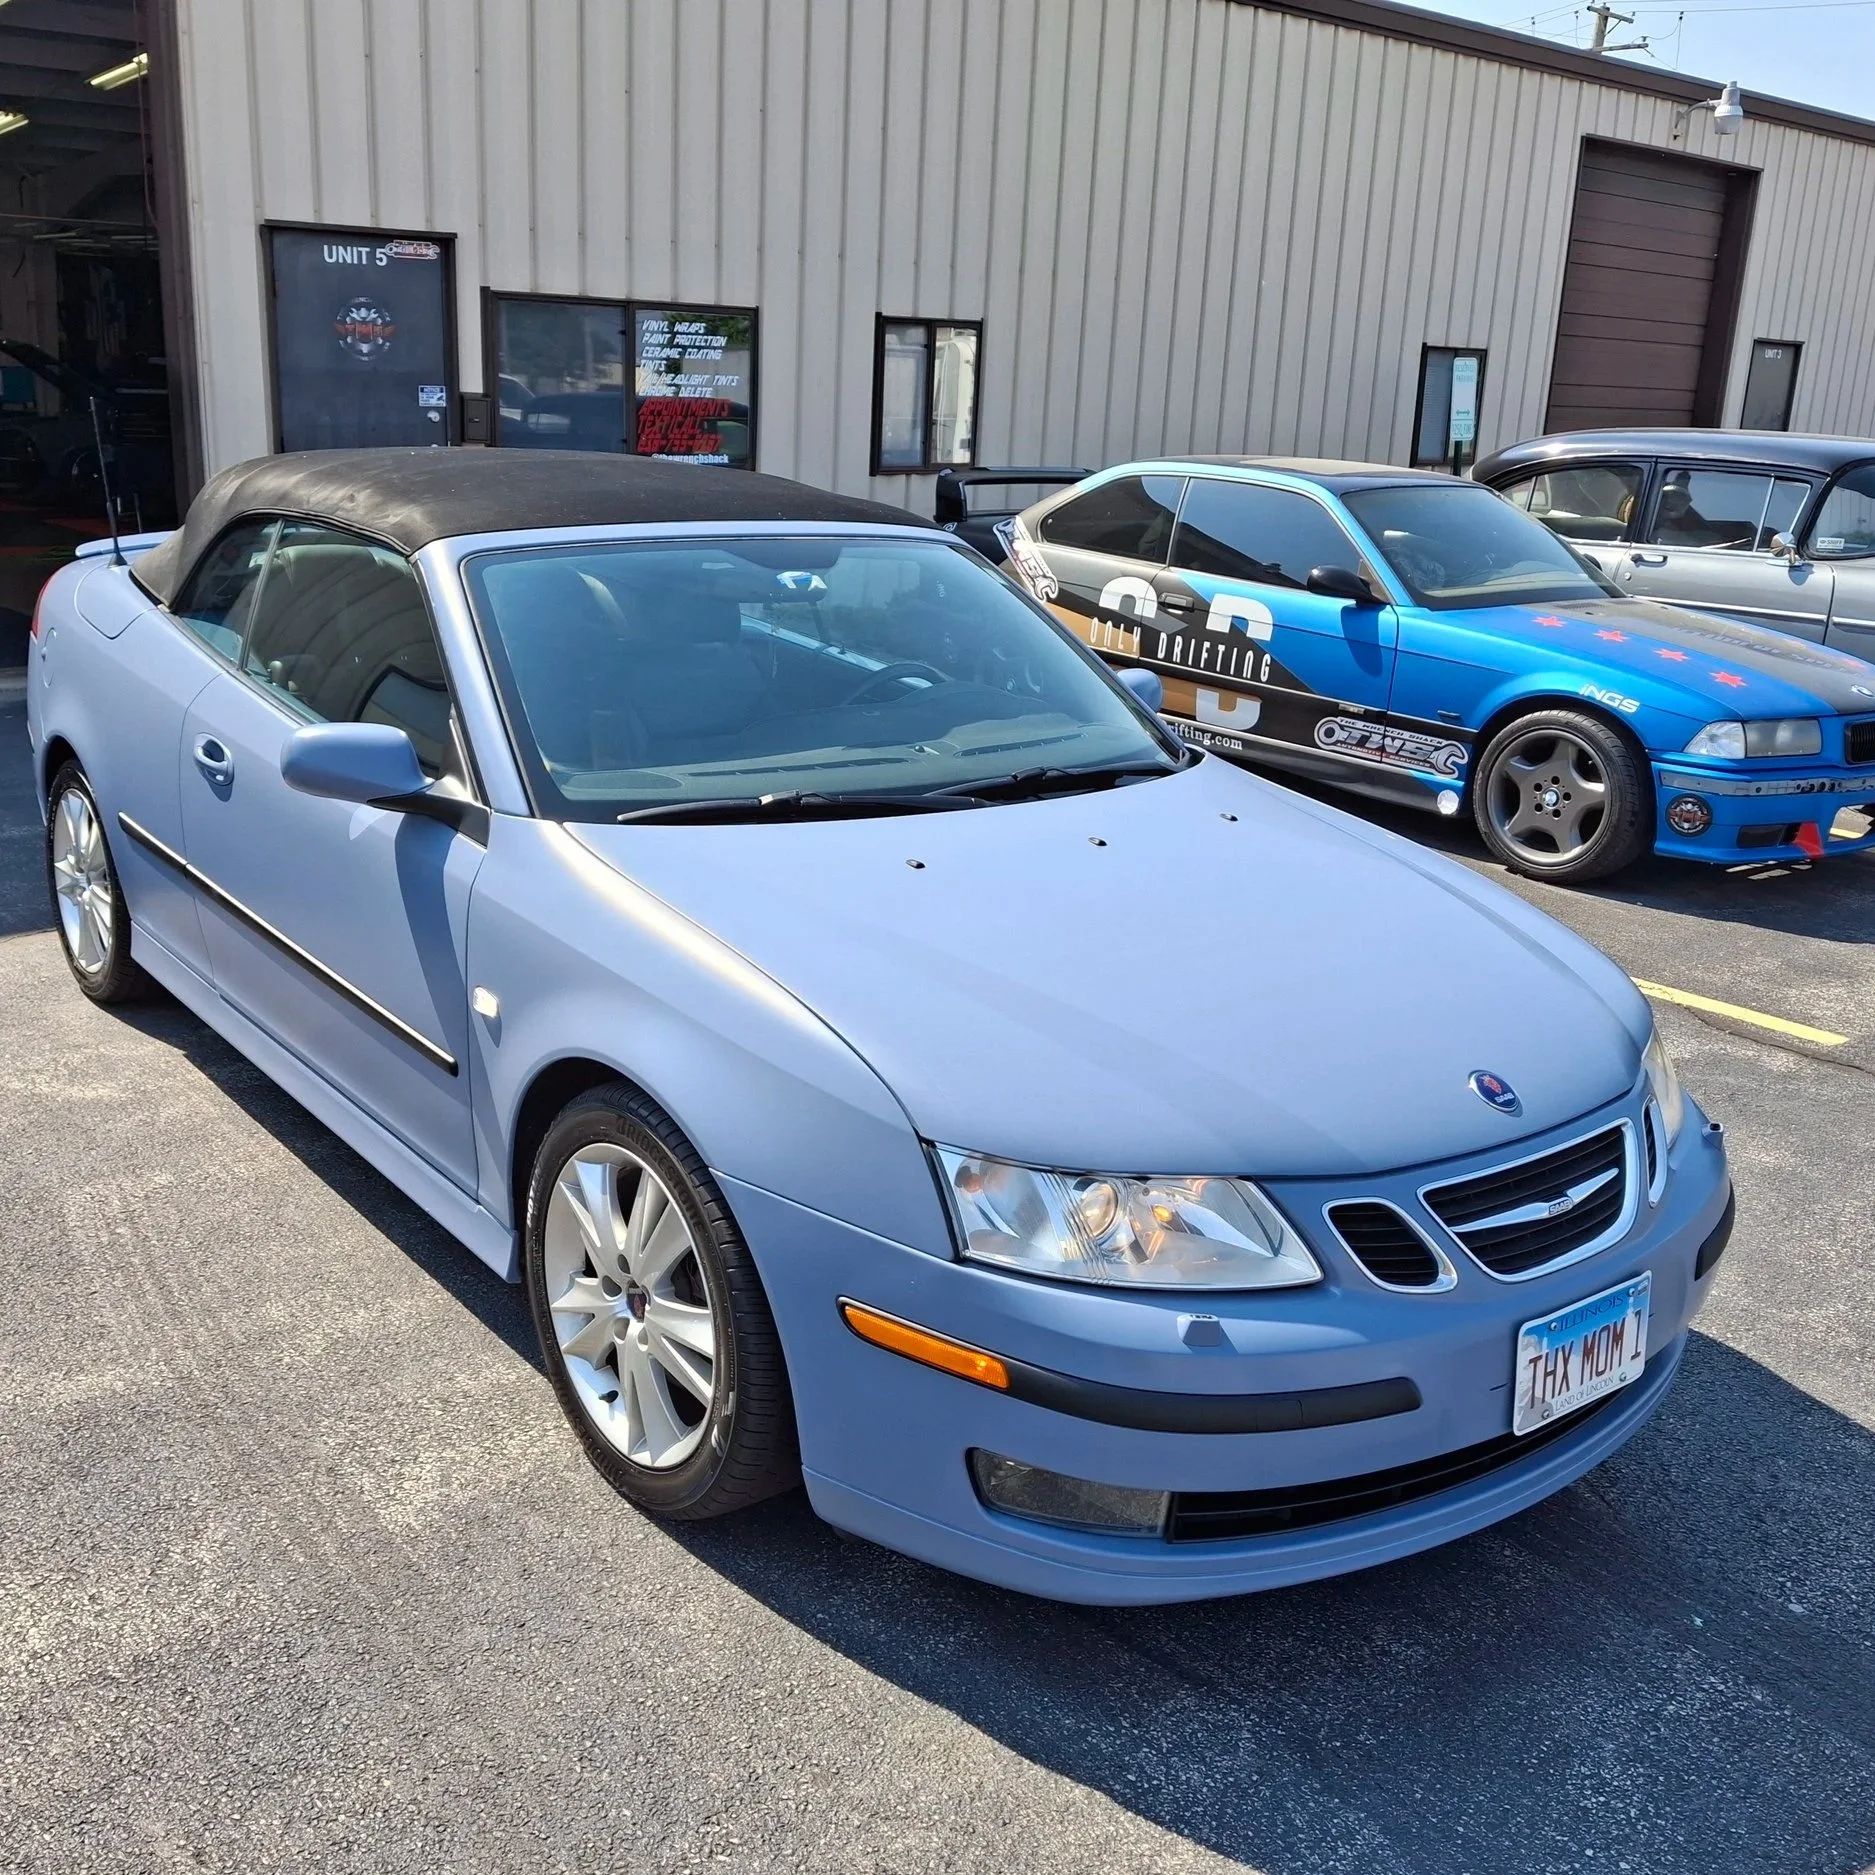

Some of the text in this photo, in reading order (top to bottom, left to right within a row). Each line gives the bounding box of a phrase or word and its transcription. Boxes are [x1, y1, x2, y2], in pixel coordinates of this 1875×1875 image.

[323, 244, 370, 265] UNIT
[375, 247, 388, 267] 5
[642, 319, 707, 334] VINYL WRAPS
[642, 333, 728, 347] PAINT PROTECTION
[642, 346, 723, 360] CERAMIC COATING
[640, 360, 667, 371] TINTS
[712, 374, 740, 387] TINTS
[639, 385, 714, 398] CHROME DELETE
[637, 397, 733, 418] APPOINTMENTS
[1090, 616, 1272, 683] ONLY DRIFTING
[1339, 718, 1445, 746] THE WRENCH SHACK
[1343, 727, 1437, 761] TWS
[1494, 1092, 1515, 1104] SAAB
[1549, 1199, 1571, 1212] SAAB
[1559, 1292, 1624, 1333] ILLINOIS
[1528, 1340, 1575, 1410] THX
[1579, 1316, 1627, 1386] MOM
[1553, 1375, 1615, 1412] LAND OF LINCOLN
